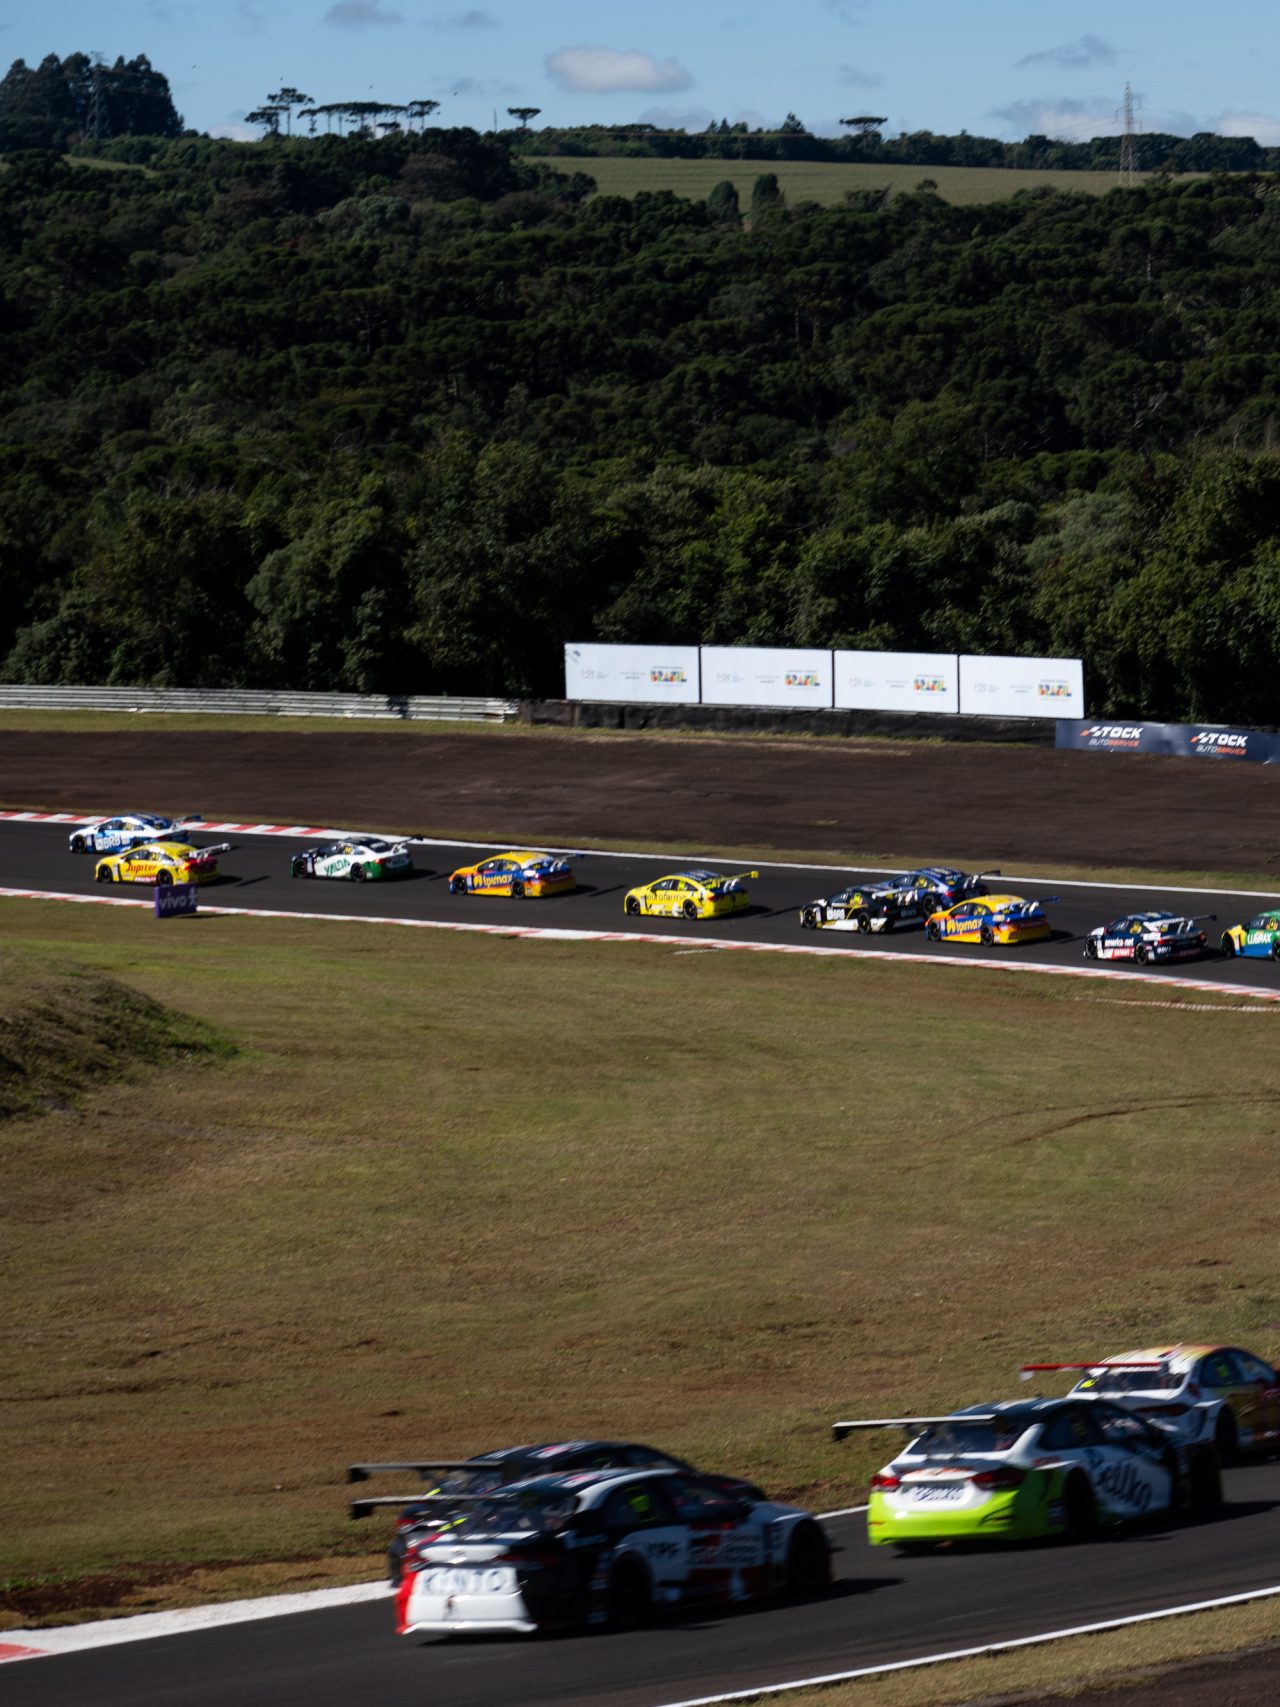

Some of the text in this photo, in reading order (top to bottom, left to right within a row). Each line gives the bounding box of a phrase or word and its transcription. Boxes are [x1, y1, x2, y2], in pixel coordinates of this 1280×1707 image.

[1085, 726, 1144, 739] STOCK
[1195, 732, 1248, 747] STOCK
[126, 863, 157, 875] Jupiter
[159, 892, 187, 909] vivo
